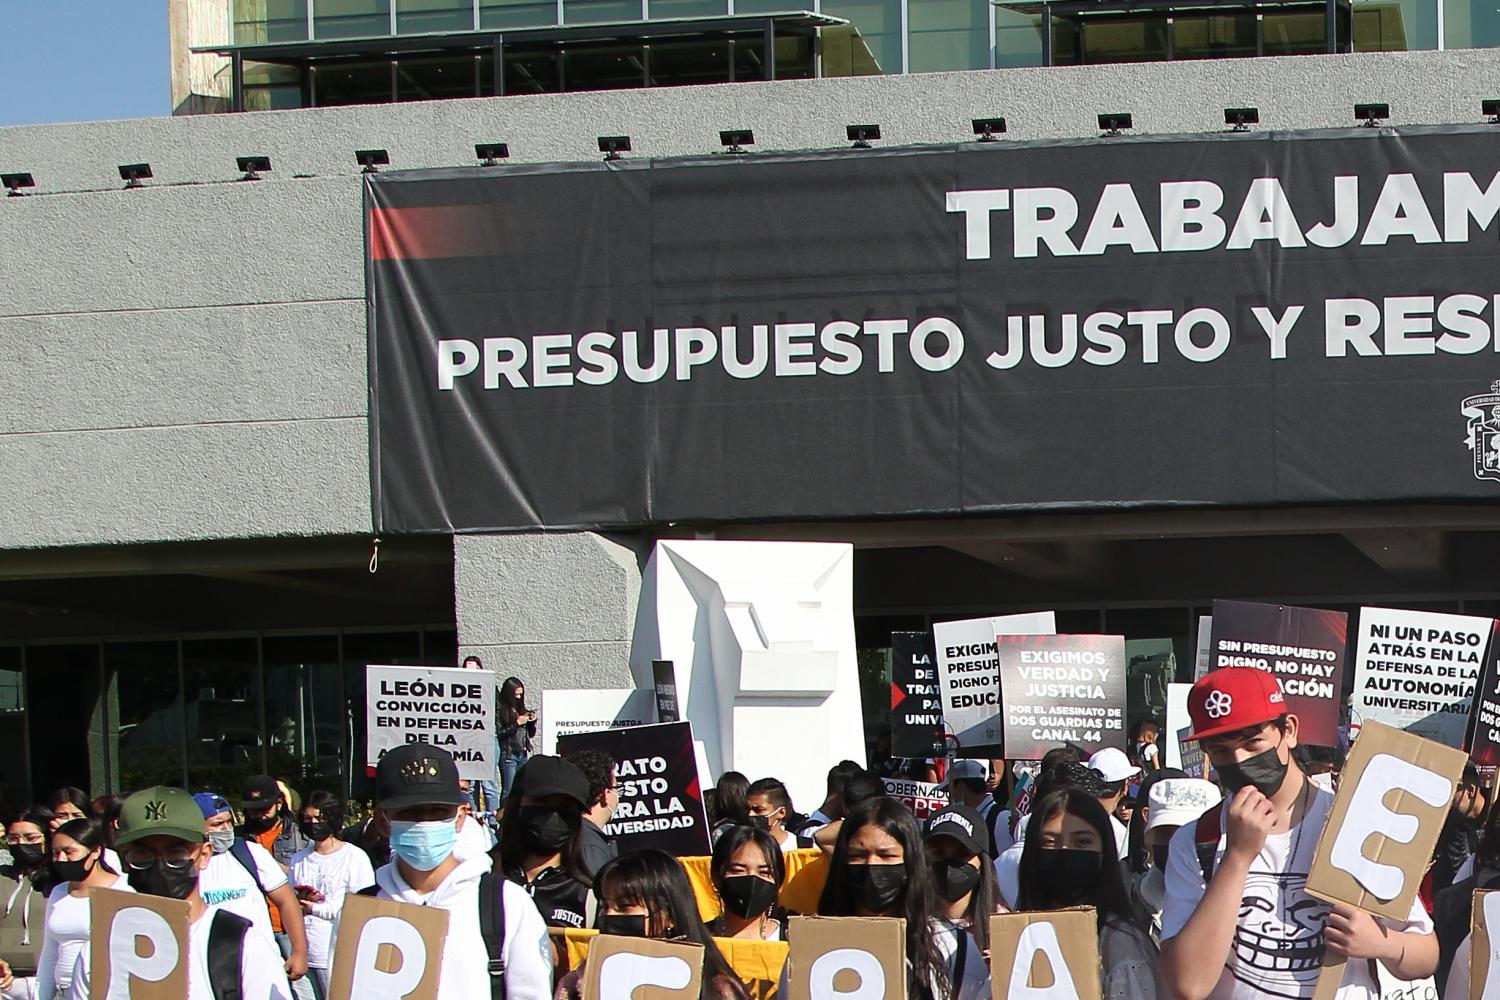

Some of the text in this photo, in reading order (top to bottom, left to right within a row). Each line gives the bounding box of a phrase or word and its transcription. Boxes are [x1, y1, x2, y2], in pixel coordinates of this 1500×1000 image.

[437, 317, 965, 390] PRESUPUESTO
[985, 307, 1231, 370] JUSTO
[1250, 305, 1305, 359] Y
[1370, 623, 1481, 647] NI UN PASO
[946, 642, 998, 658] EXIGIM
[1020, 650, 1106, 665] EXIGIMOS
[1218, 640, 1337, 661] SIN PRESUPUESTO
[1368, 642, 1479, 663] ATRÁS EN LA
[912, 653, 931, 664] LA
[915, 669, 934, 680] DE
[1018, 666, 1110, 682] VERDAD Y
[1217, 655, 1272, 673] DIGNO,
[1275, 660, 1299, 674] NO
[1301, 663, 1335, 679] HAY
[1366, 660, 1479, 680] DEFENSA DE LA
[380, 678, 482, 699] LEÓN DE
[950, 676, 990, 689] DIGNO
[1365, 676, 1474, 698] AUTONOMÍA
[1026, 683, 1106, 700] JUSTICIA
[376, 700, 486, 716] CONVICCIÓN,
[1009, 705, 1122, 717] POR EL ASESINATO DE
[1482, 700, 1495, 712] POR
[376, 716, 485, 731] EN DEFENSA
[1009, 716, 1122, 729] DOS GUARDIAS DE
[1480, 710, 1495, 724] DOS
[405, 733, 457, 746] DE LA
[1032, 728, 1101, 743] CANAL 44
[614, 757, 667, 777] RATO
[885, 782, 950, 798] OBERNAD
[654, 796, 686, 816] LA
[600, 815, 694, 836] NIVERSIDAD
[930, 811, 974, 837] CALIFORNIA
[551, 908, 584, 928] JUSTICE
